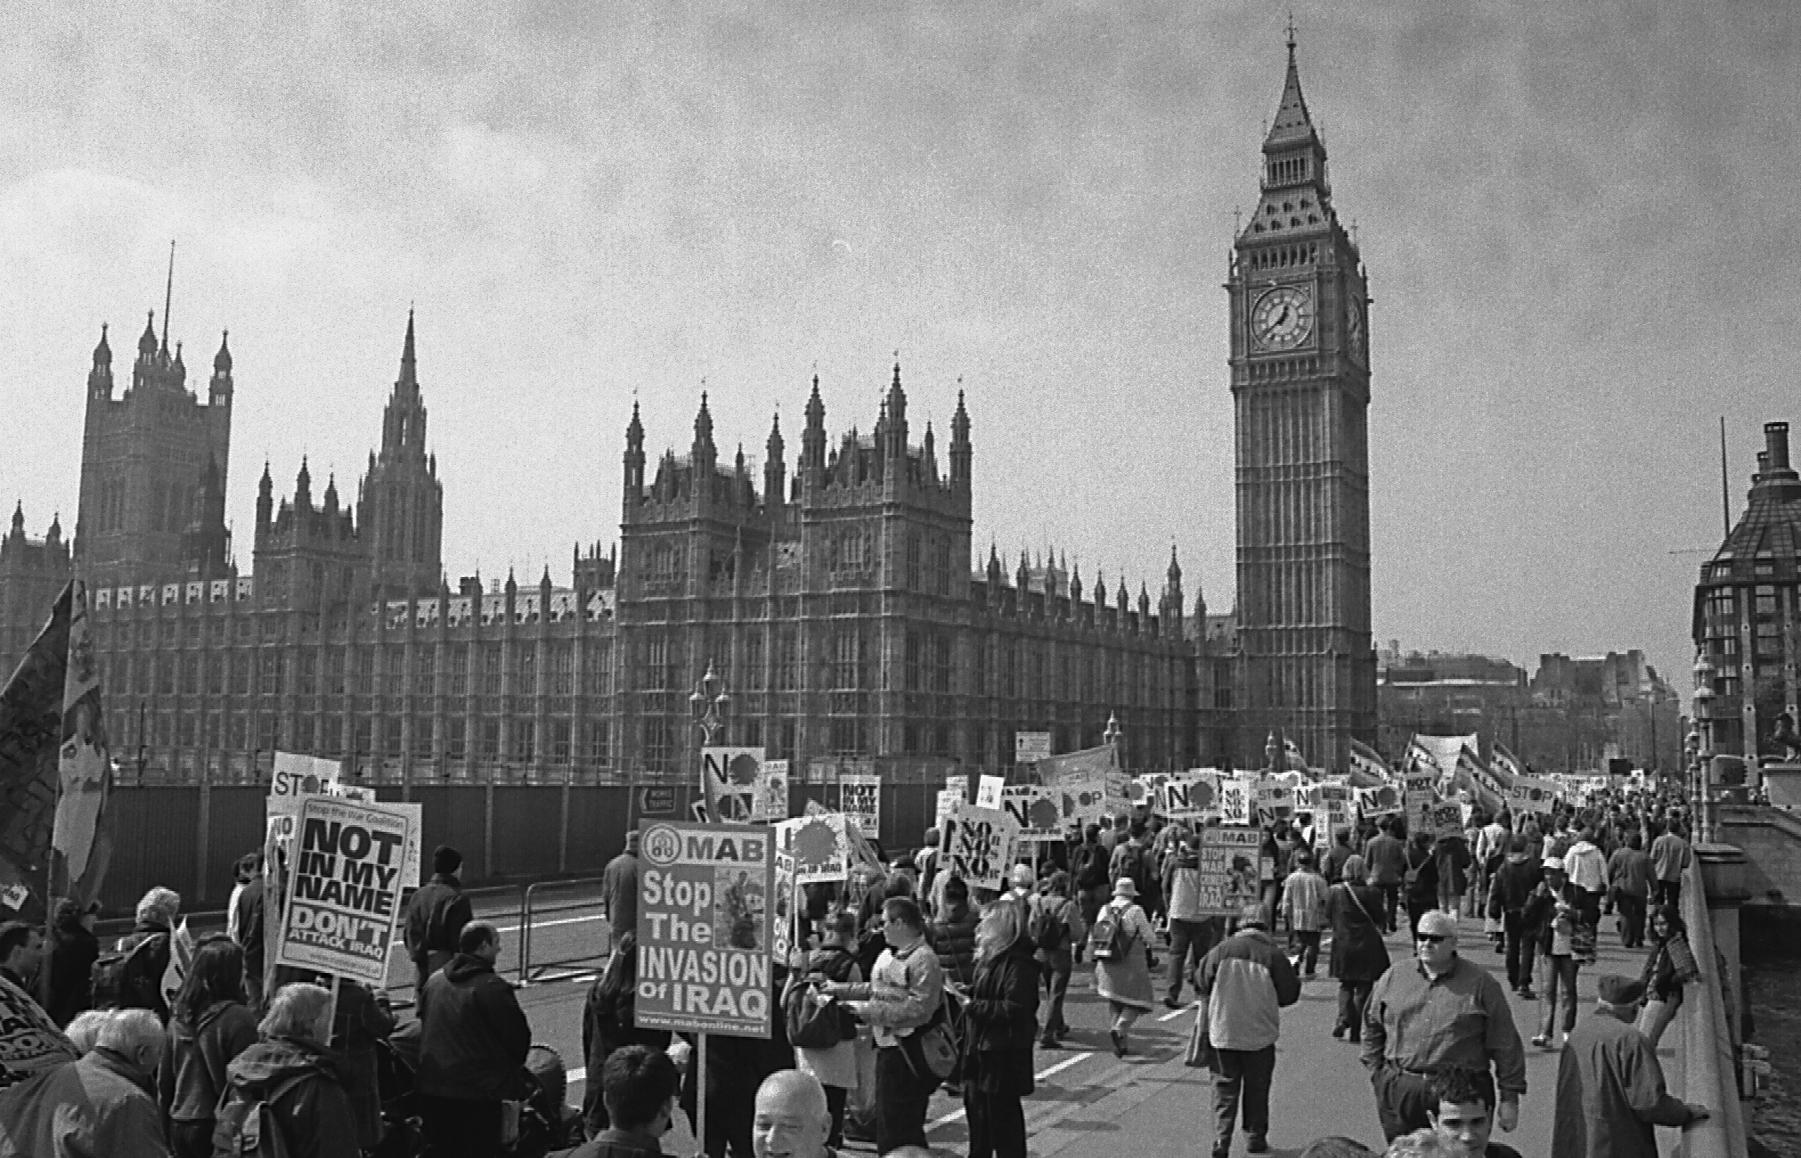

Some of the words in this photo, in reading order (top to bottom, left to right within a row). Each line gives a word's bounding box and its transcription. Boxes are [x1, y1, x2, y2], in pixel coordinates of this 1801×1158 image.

[843, 784, 877, 796] NOT
[302, 818, 403, 865] NOT
[687, 836, 764, 862] MAB
[1223, 832, 1257, 844] MAB
[298, 851, 336, 878] IN
[342, 860, 398, 891] MY
[294, 874, 394, 916] NAME
[643, 870, 711, 916] Stop
[288, 928, 346, 950] ATTACK
[349, 940, 384, 960] IRAQ
[290, 905, 389, 947] DON'T
[645, 912, 712, 944] The
[639, 945, 768, 988] INVASION
[673, 983, 768, 1021] IRAQ
[639, 1015, 766, 1033] www.mabonline.net
